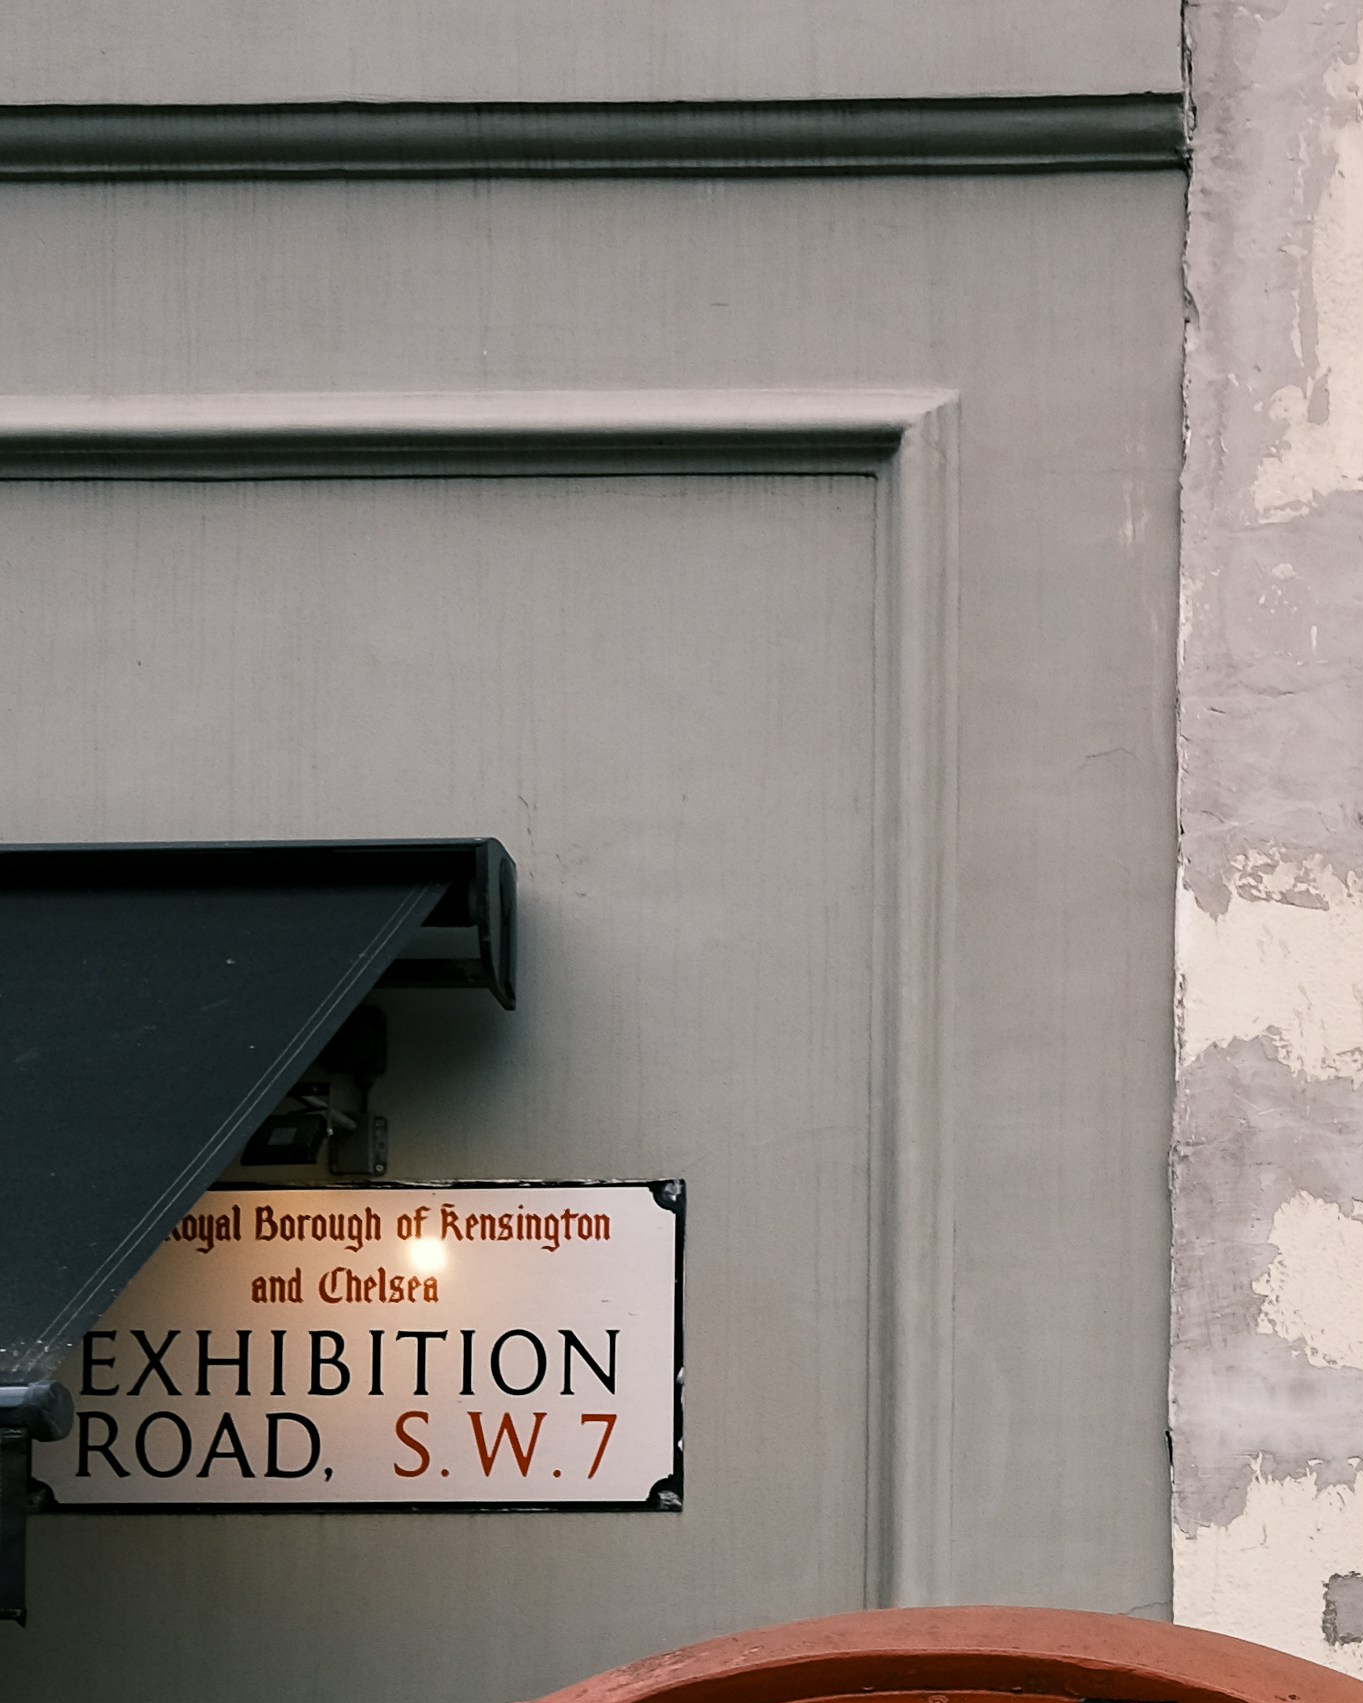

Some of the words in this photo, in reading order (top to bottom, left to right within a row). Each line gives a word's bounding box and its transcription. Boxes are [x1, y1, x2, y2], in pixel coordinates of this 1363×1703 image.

[254, 1204, 382, 1253] Borough
[396, 1205, 431, 1241] of
[440, 1203, 611, 1252] Kensington
[251, 1266, 304, 1304] and
[318, 1266, 440, 1304] Chelsea
[79, 1329, 621, 1397] EXHIBITION
[75, 1410, 334, 1482] ROAD,
